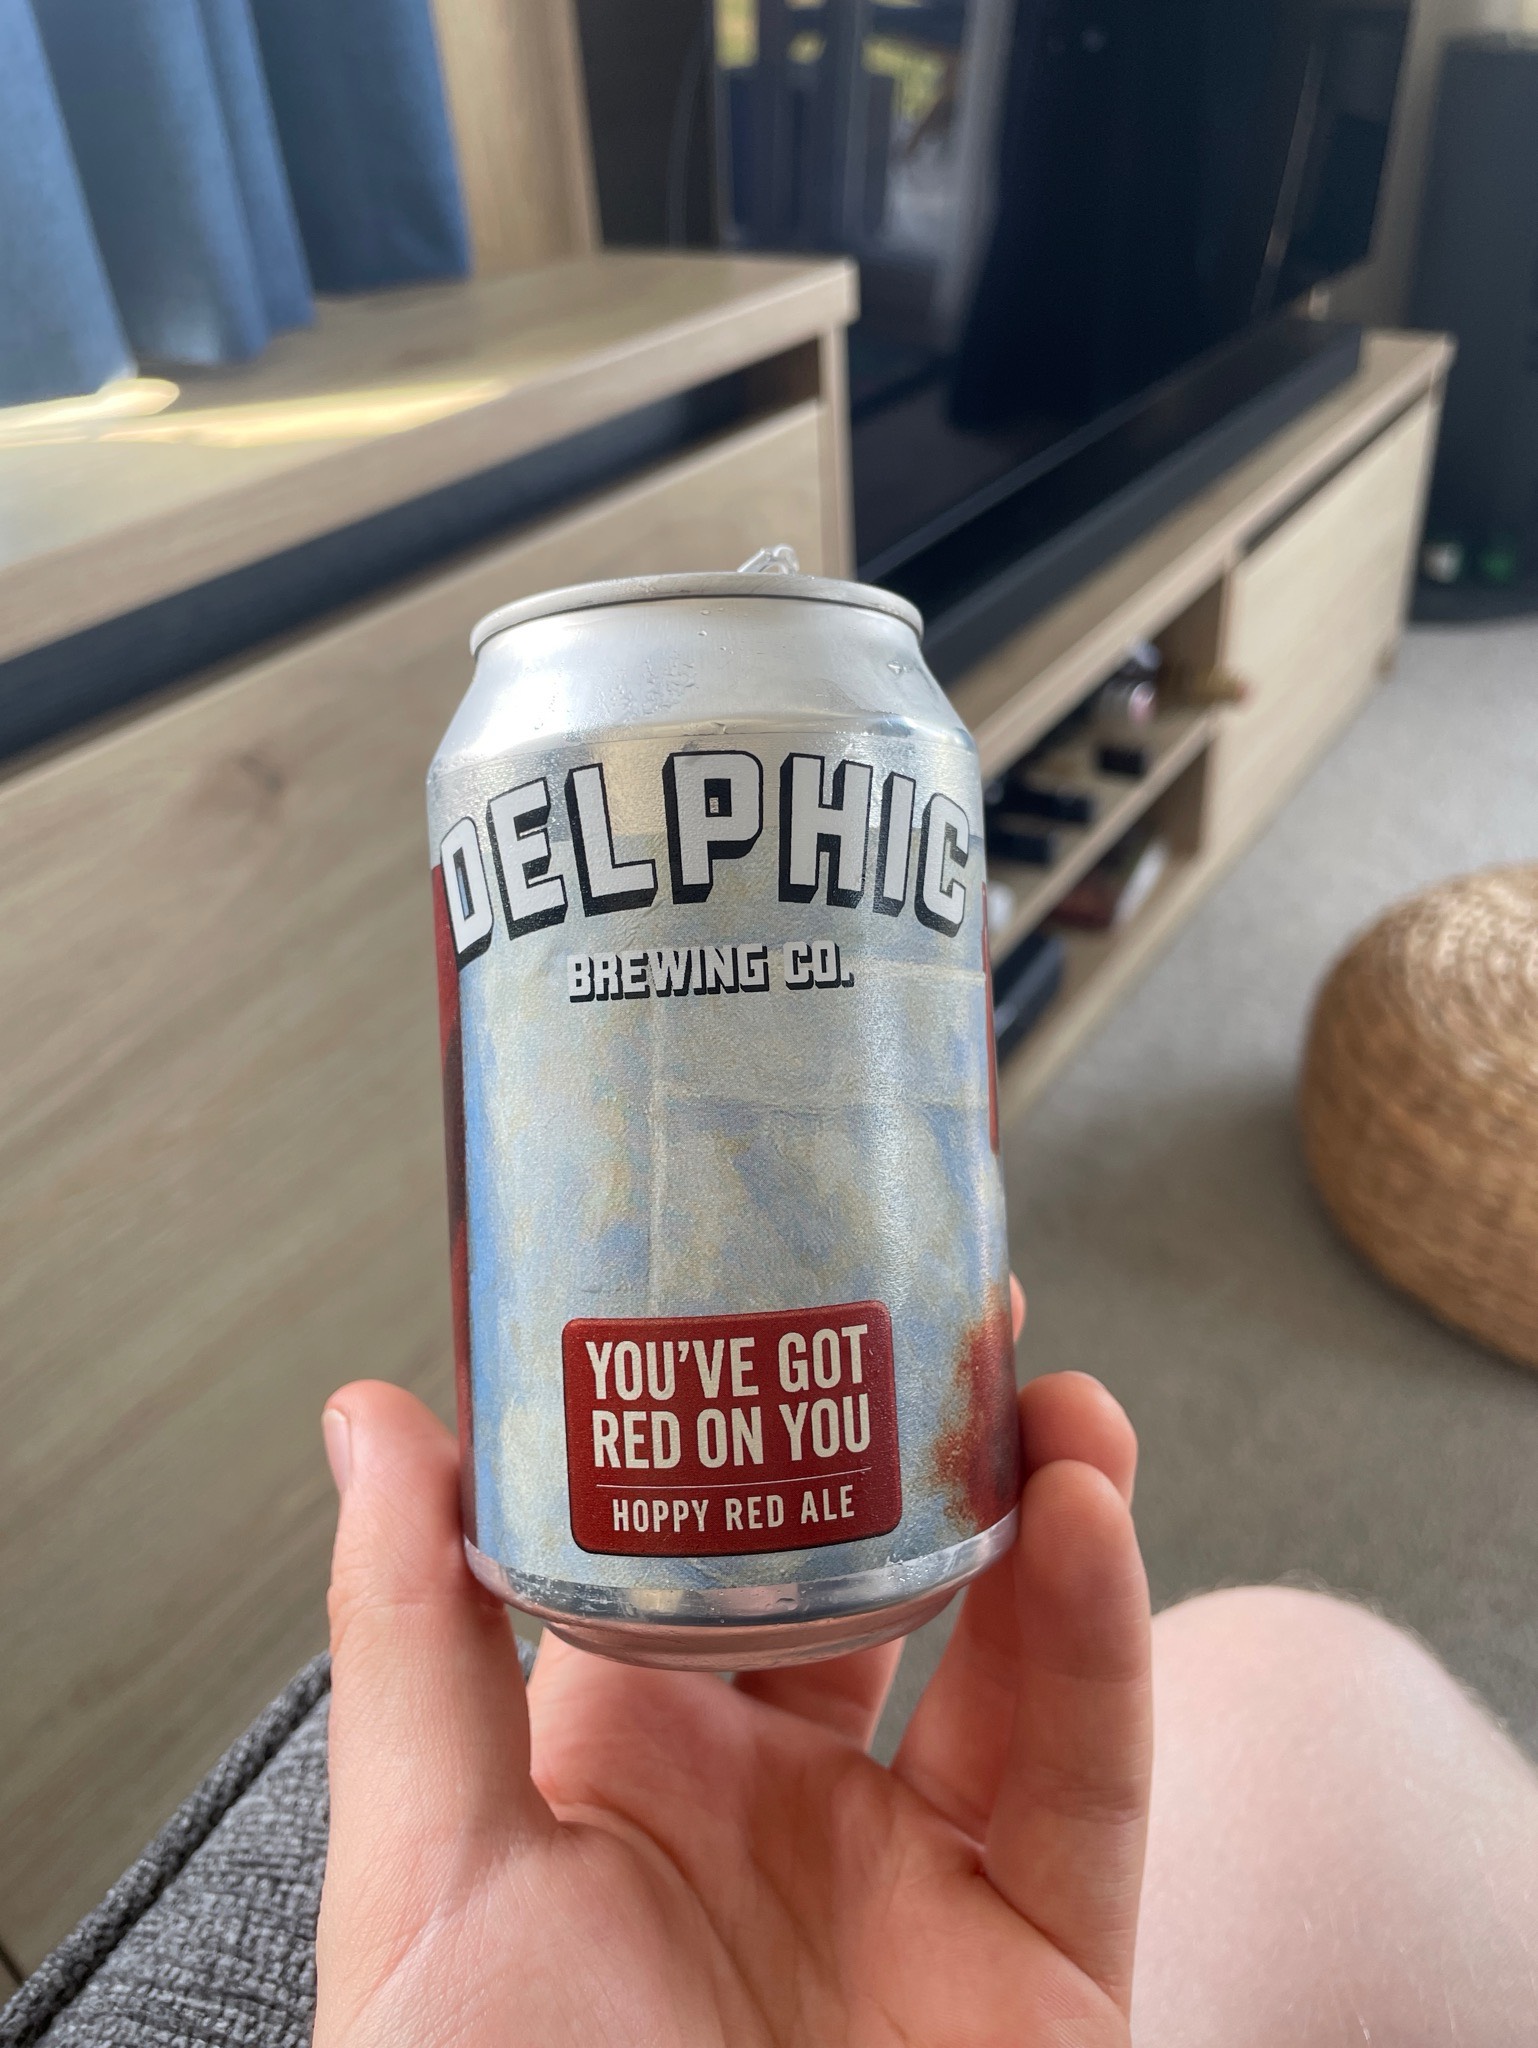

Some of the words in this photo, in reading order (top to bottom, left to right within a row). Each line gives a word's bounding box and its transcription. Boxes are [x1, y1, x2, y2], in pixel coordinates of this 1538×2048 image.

[440, 750, 970, 970] DELPHIC
[567, 943, 770, 1003] BREWING
[783, 941, 855, 989] CO.
[585, 1337, 759, 1401] YOU'VE
[778, 1324, 868, 1393] GOT
[592, 1410, 681, 1469] RED
[697, 1406, 764, 1469] ON
[779, 1393, 871, 1461] YOU
[613, 1499, 709, 1533] HOPPY
[725, 1494, 785, 1531] RED
[800, 1485, 855, 1525] ALE
